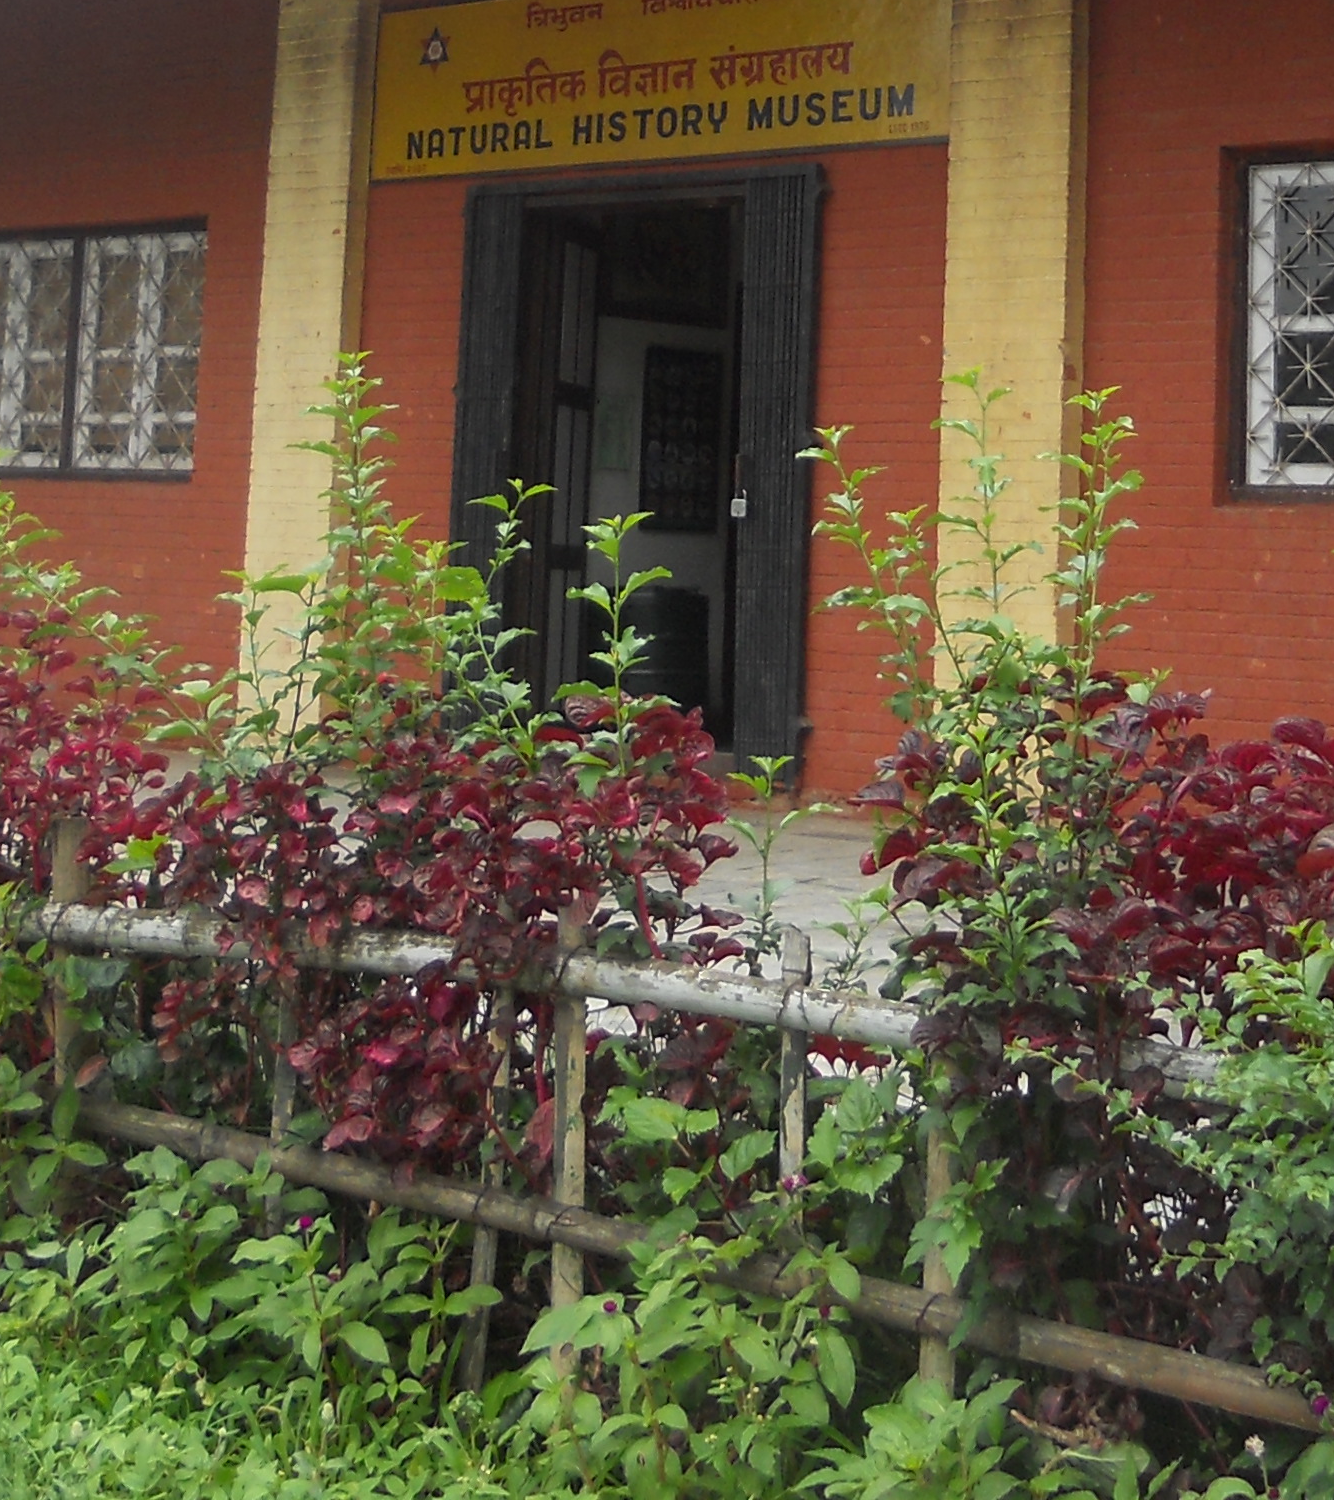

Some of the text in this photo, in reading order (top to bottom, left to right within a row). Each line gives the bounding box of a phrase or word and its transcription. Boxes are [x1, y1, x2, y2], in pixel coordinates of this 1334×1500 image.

[526, 1, 604, 32] त्रिभुवन
[462, 40, 855, 117] प्राकृतिक विज्ञान संग्रहालय
[406, 82, 915, 160] NATURAL HISTORY MUSEUM
